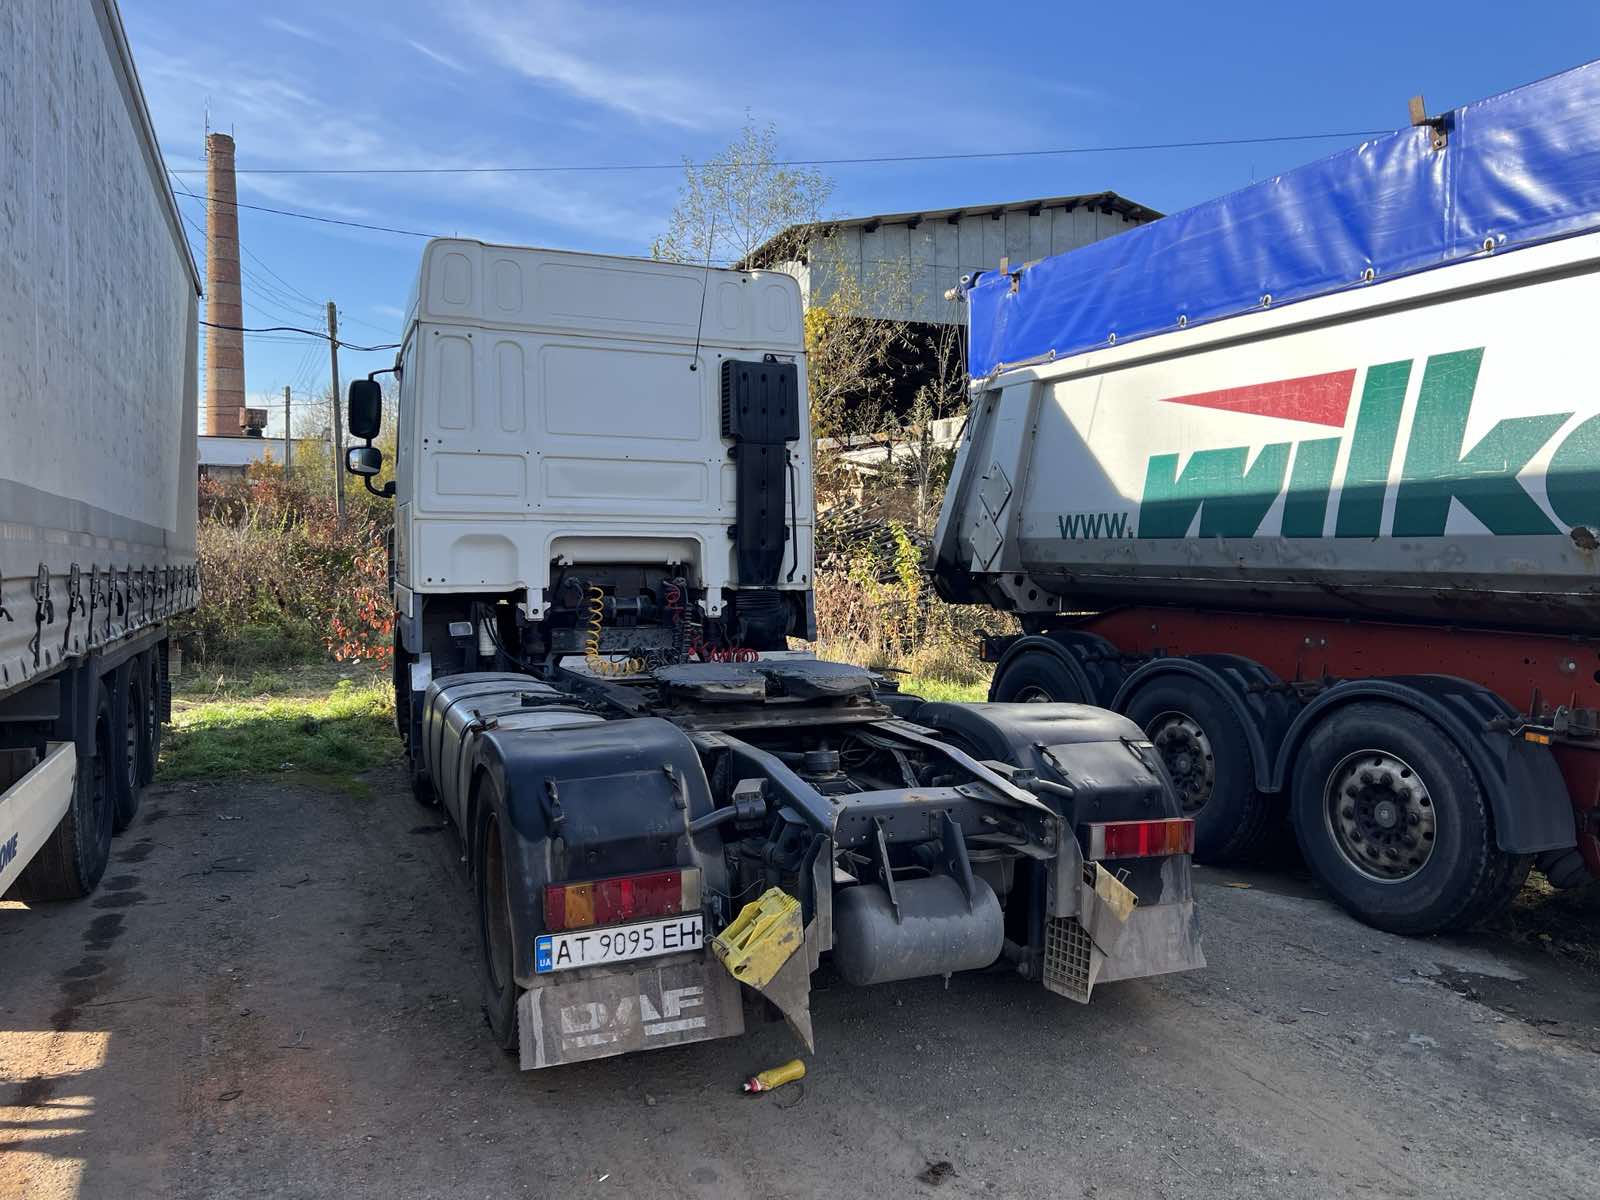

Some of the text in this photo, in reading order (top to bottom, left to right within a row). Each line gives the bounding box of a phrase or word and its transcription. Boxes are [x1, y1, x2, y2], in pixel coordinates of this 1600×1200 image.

[556, 920, 696, 965] AT 9095 EH
[539, 959, 551, 967] UA
